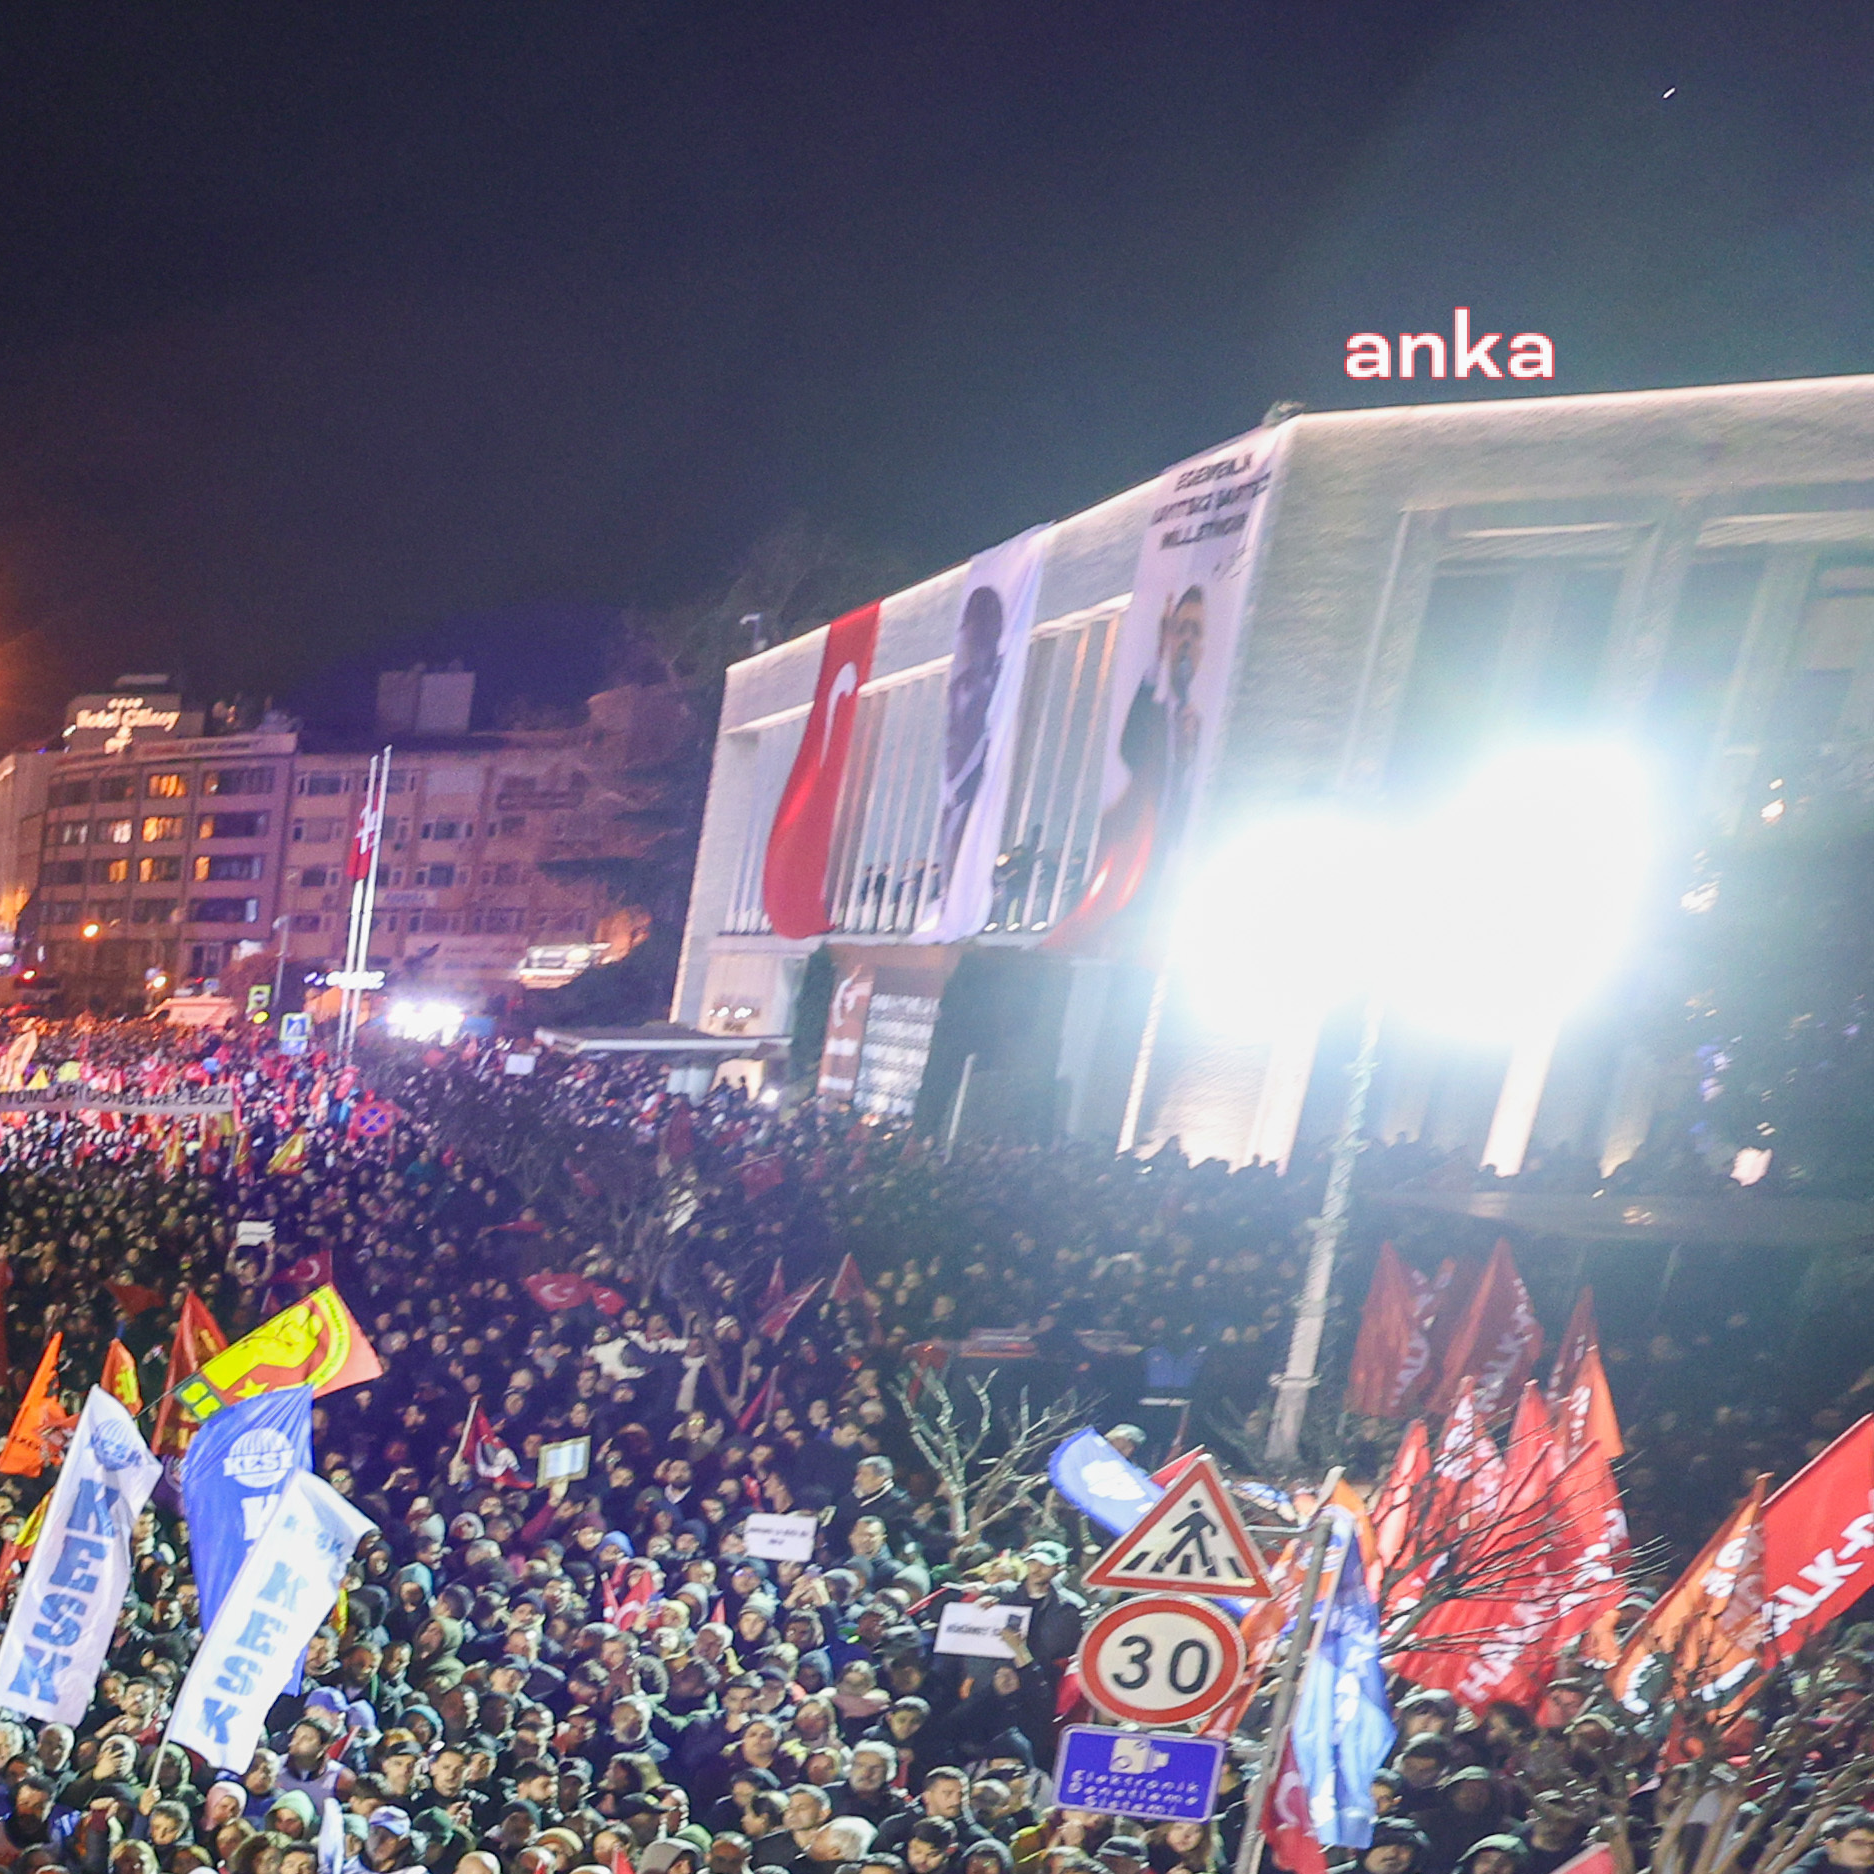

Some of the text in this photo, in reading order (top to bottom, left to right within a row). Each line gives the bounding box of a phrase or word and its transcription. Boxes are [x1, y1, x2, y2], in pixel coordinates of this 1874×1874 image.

[223, 1450, 296, 1476] KESK
[9, 1478, 119, 1705] KESK
[199, 1560, 309, 1745] KESK
[1112, 1635, 1209, 1694] 30
[1068, 1781, 1199, 1806] Denetleme
[1071, 1769, 1199, 1793] Elektronik
[1084, 1794, 1177, 1815] Sistemi
